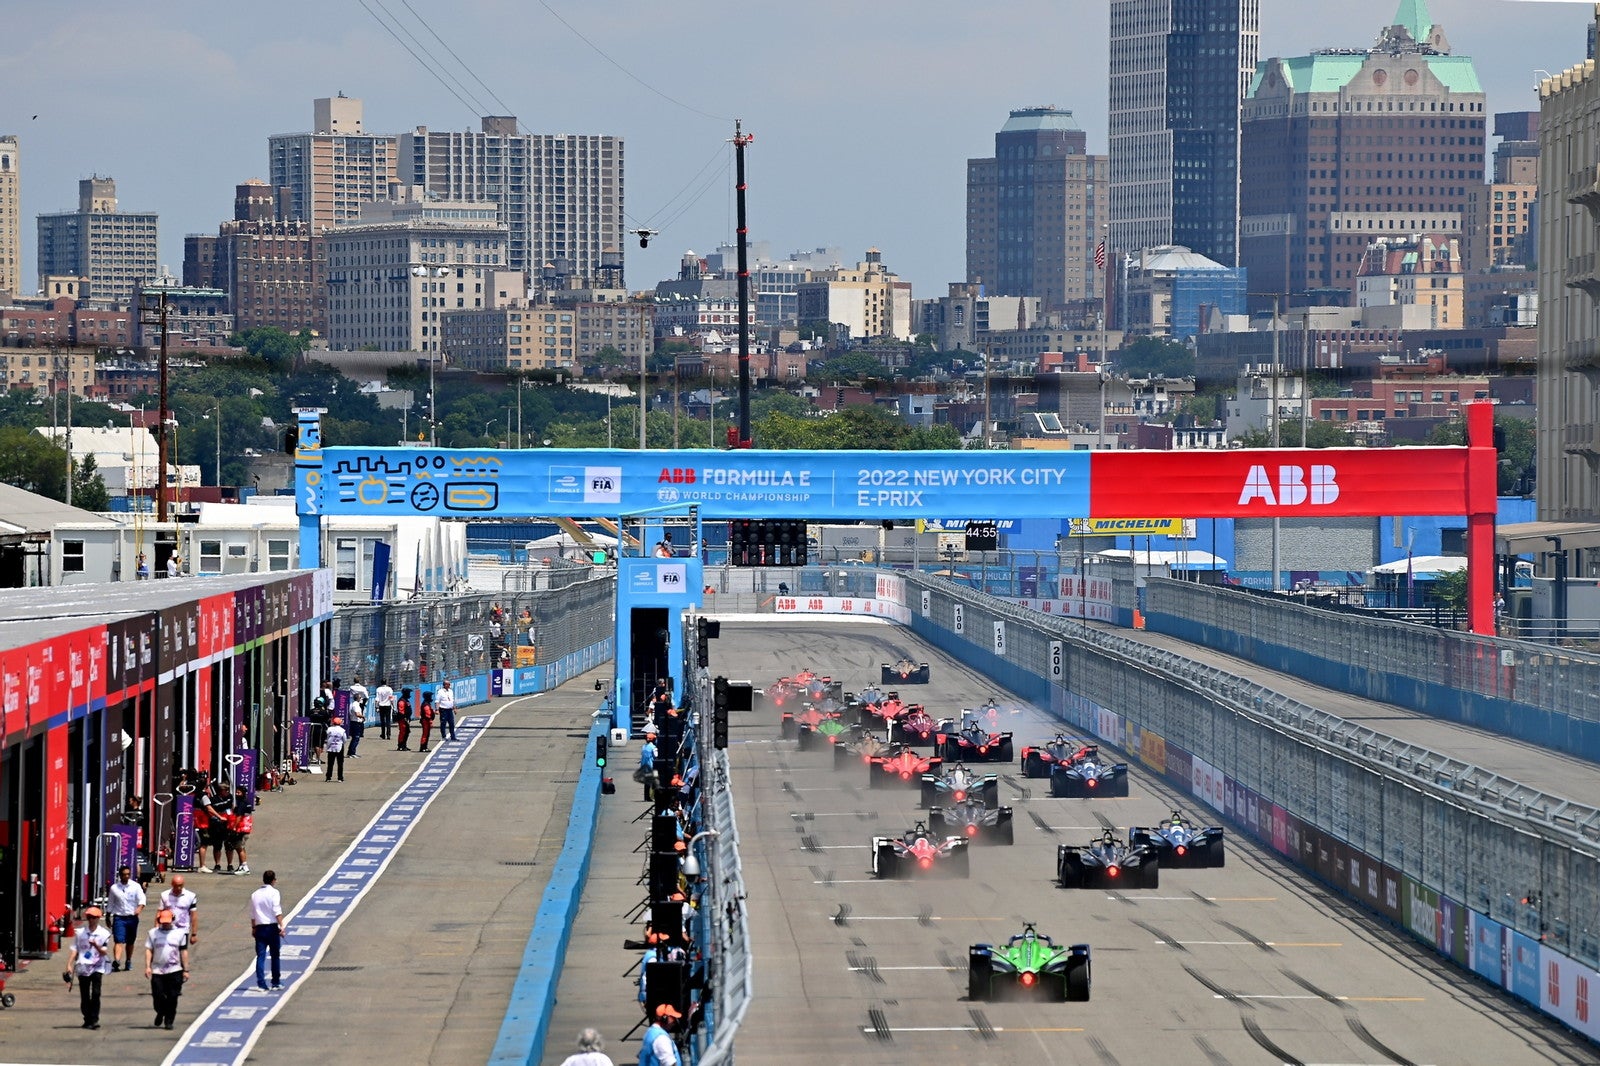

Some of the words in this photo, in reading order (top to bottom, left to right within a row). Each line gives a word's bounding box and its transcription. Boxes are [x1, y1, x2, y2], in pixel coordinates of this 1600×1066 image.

[657, 468, 696, 484] ABB
[702, 468, 795, 486] FORMULA
[800, 470, 811, 486] E
[857, 469, 909, 486] 2022
[914, 469, 958, 486] NEW
[961, 468, 1016, 485] YORK
[1021, 468, 1067, 485] CITY
[1238, 465, 1340, 505] ABB
[683, 492, 721, 500] WORLD
[725, 492, 811, 502] CHAMPIONSHIP
[857, 490, 923, 507] E-PRIX
[966, 527, 997, 538] 44:55
[1095, 519, 1172, 529] MICHELIN
[777, 598, 796, 610] ABB
[808, 598, 823, 610] ABB
[923, 597, 929, 610] 50
[1053, 646, 1061, 675] 200
[180, 836, 189, 861] enel
[1548, 959, 1560, 1008] ABB
[1576, 974, 1589, 1024] ABB
